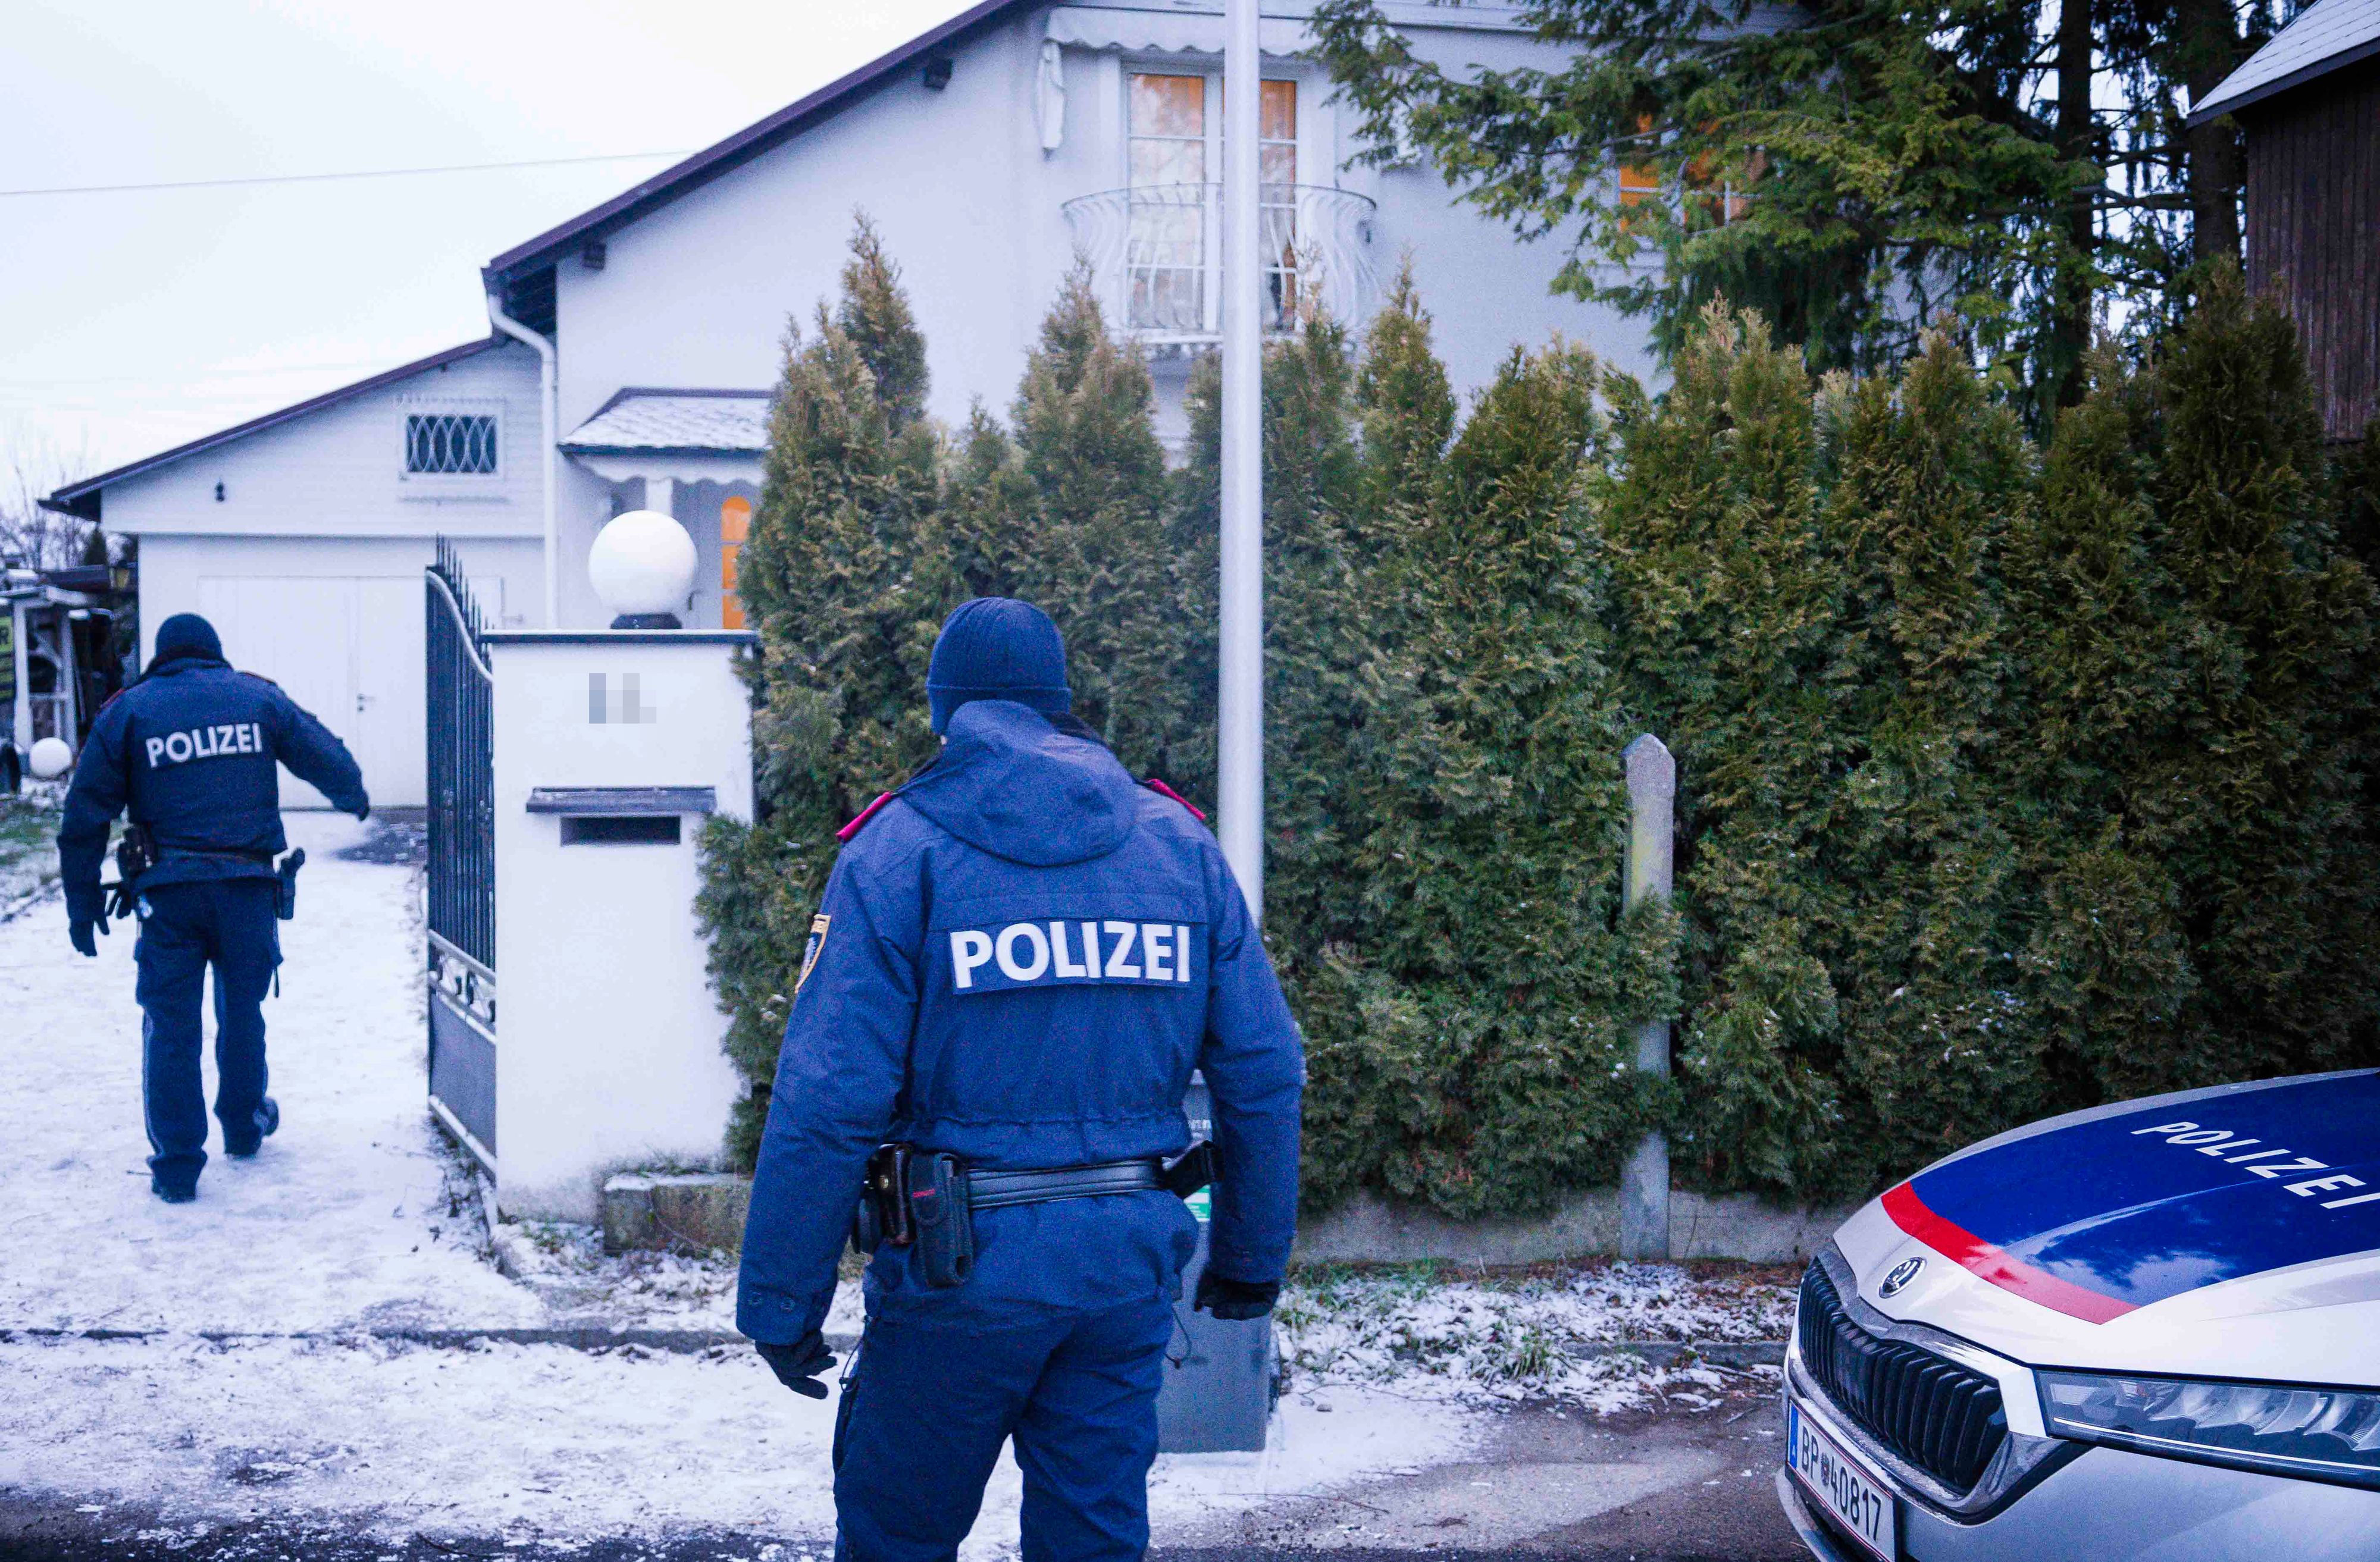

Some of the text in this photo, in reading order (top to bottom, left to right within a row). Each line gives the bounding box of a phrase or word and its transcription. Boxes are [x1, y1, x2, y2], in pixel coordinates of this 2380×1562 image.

[145, 722, 262, 769] POLIZEI
[950, 920, 1191, 989] POLIZEI
[2130, 1121, 2380, 1209] POLIZEI
[1802, 1426, 1882, 1542] BP 40817
